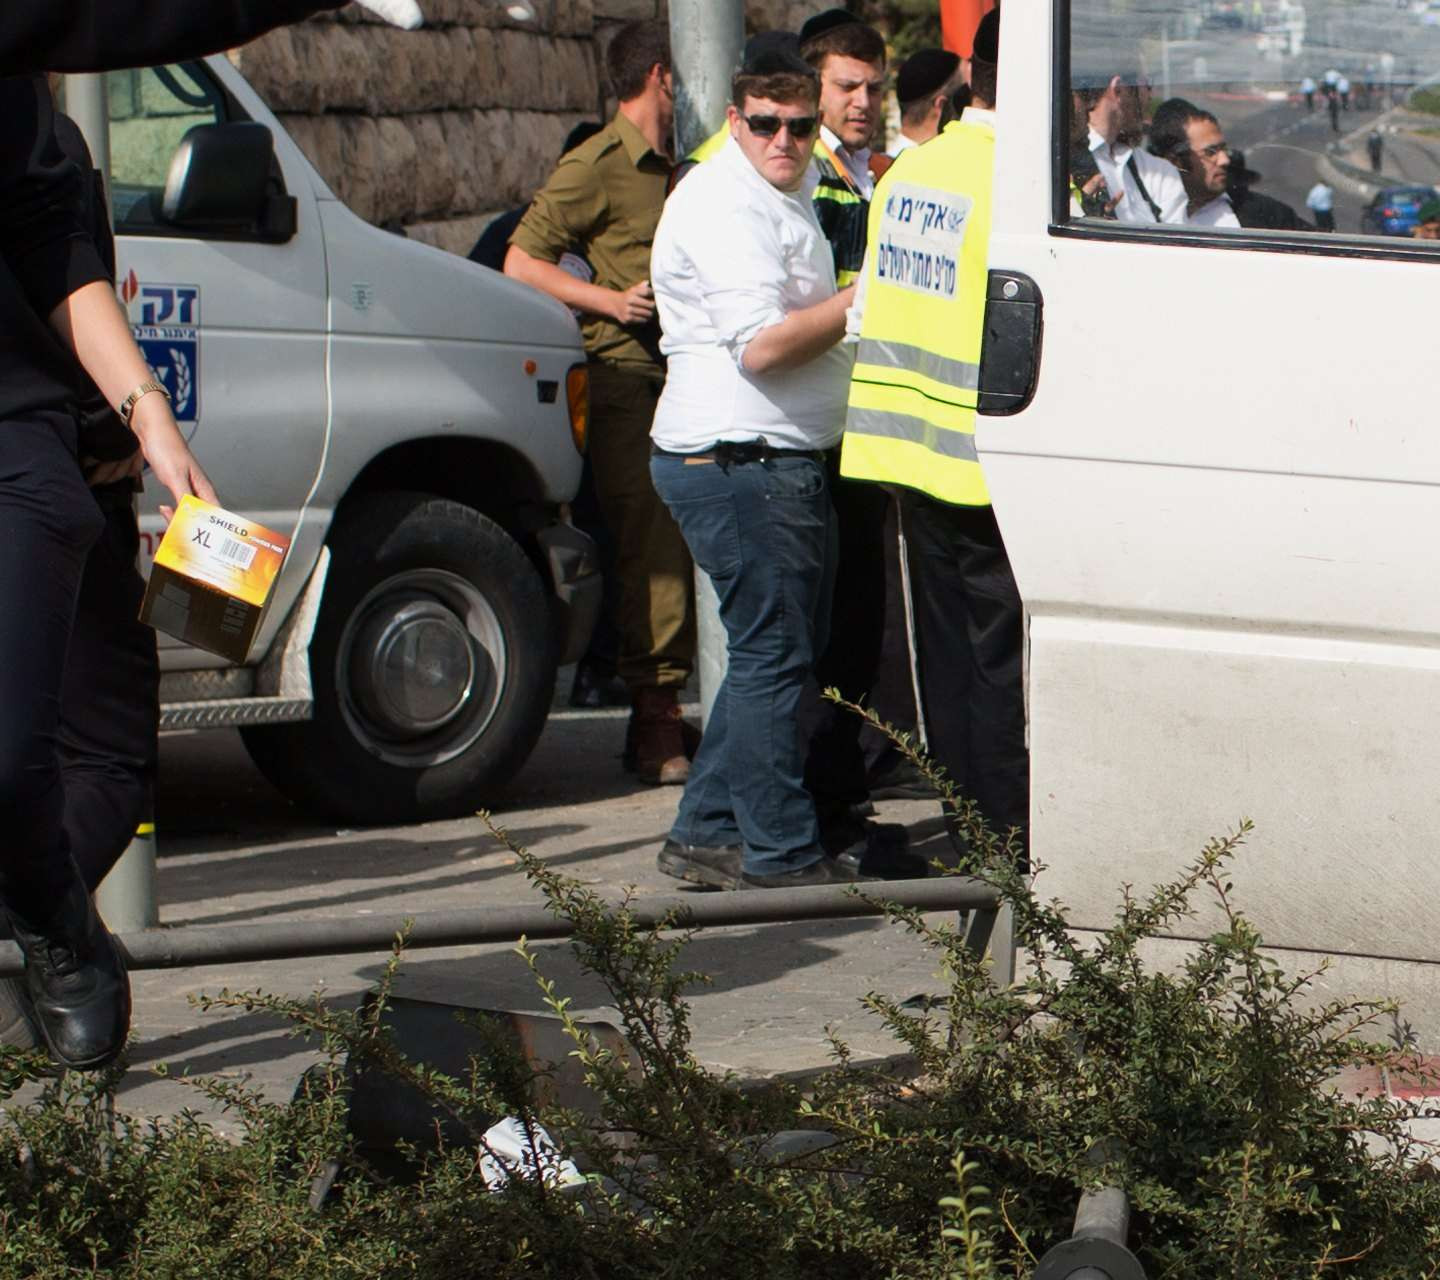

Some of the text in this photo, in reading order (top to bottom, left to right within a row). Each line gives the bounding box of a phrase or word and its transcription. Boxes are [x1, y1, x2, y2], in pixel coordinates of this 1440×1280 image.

[142, 287, 197, 326] זק
[192, 527, 211, 549] XL
[209, 514, 249, 538] SHIELD
